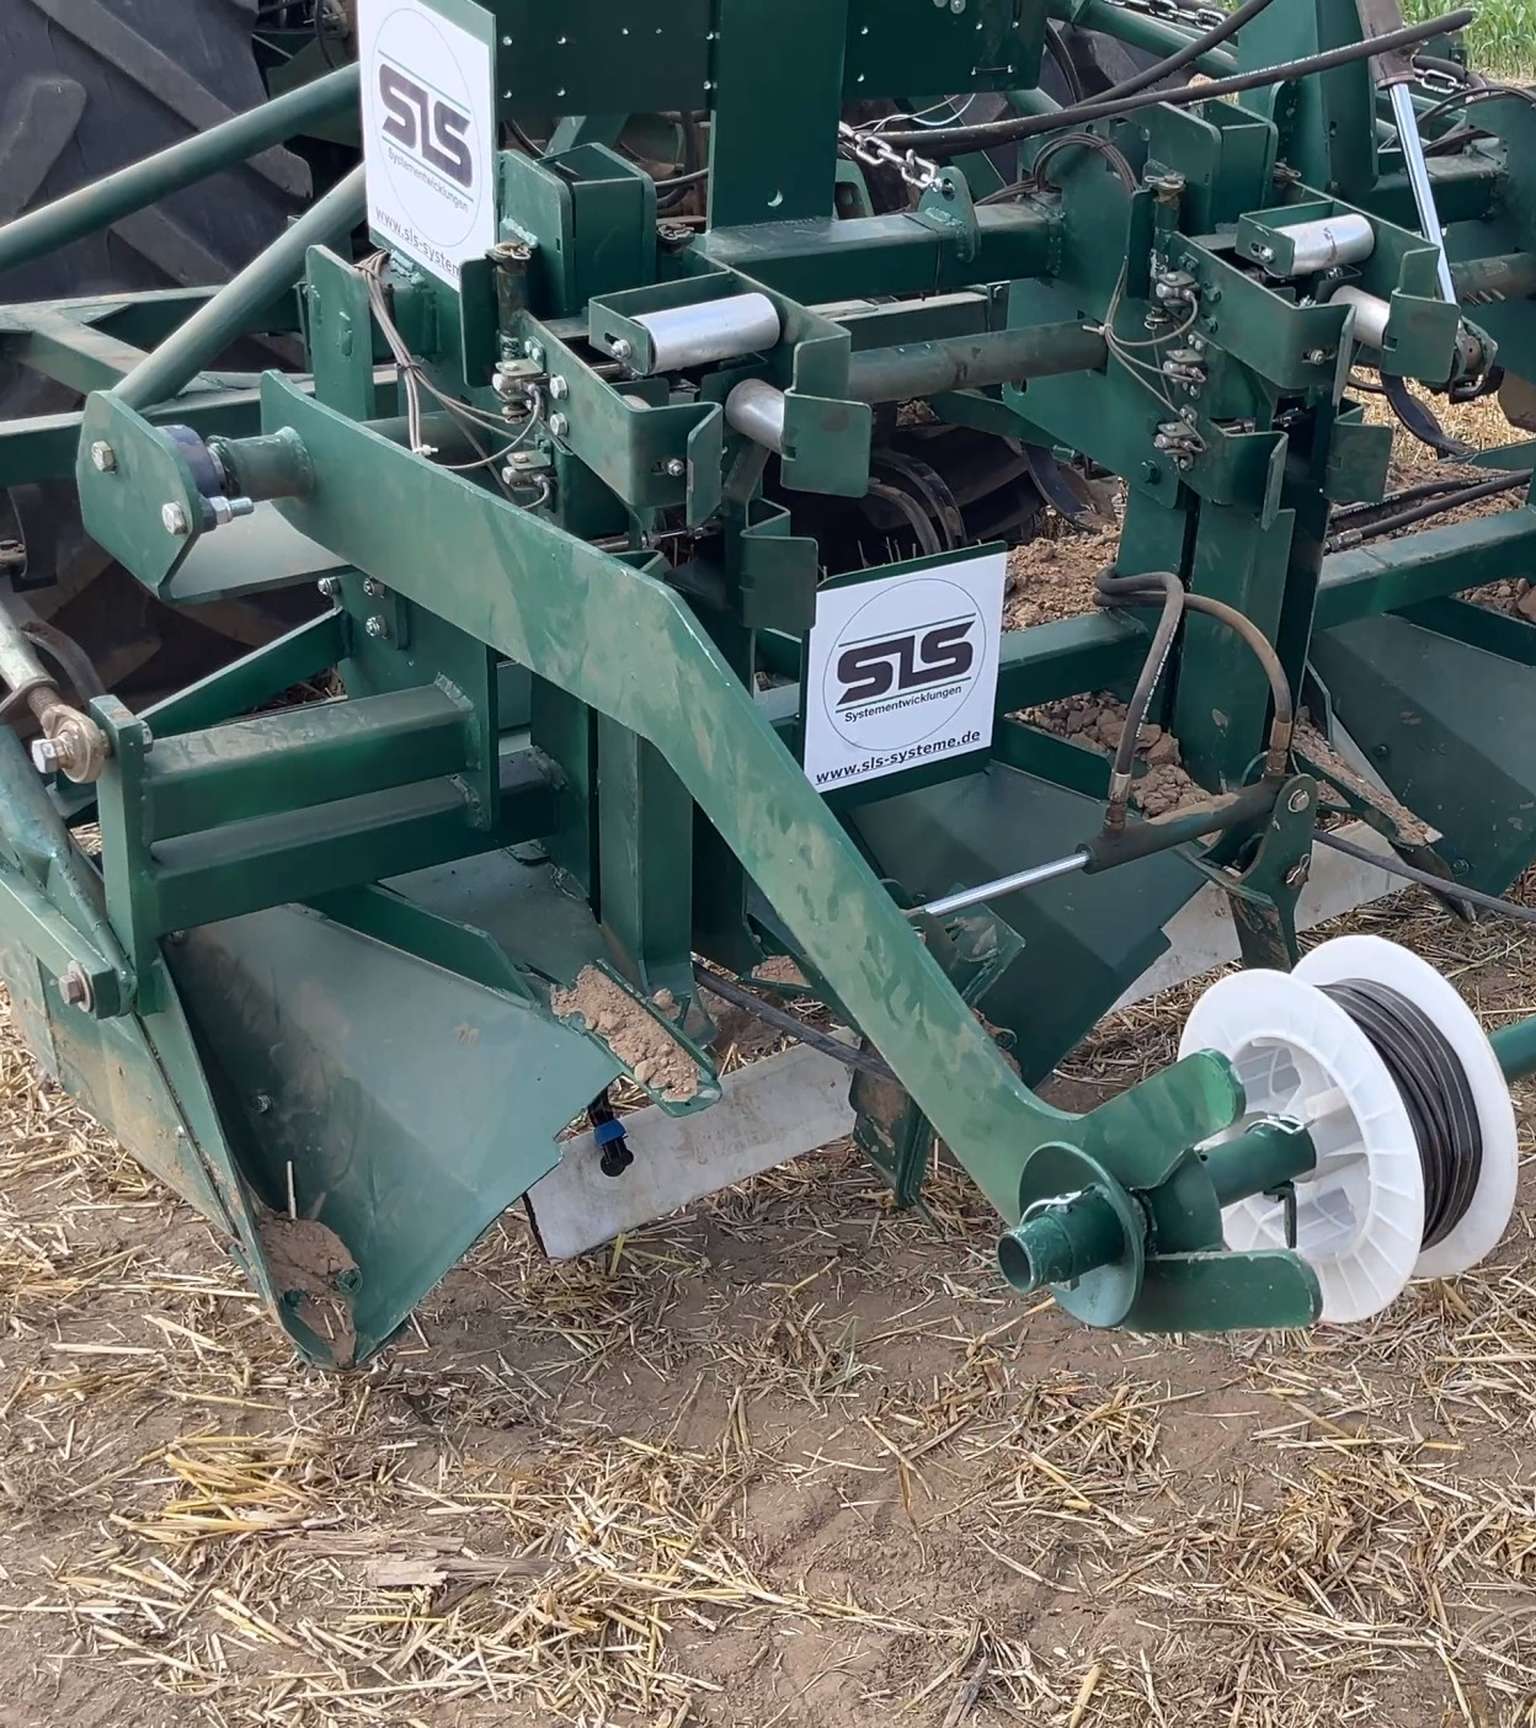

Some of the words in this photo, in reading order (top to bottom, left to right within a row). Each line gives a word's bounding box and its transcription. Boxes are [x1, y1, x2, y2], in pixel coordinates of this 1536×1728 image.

[379, 63, 473, 188] SLS
[387, 146, 469, 213] Systementwicklungen
[836, 620, 975, 706] SLS
[844, 684, 963, 722] Systementwicklungen
[815, 729, 981, 785] www.sls-systeme.de
